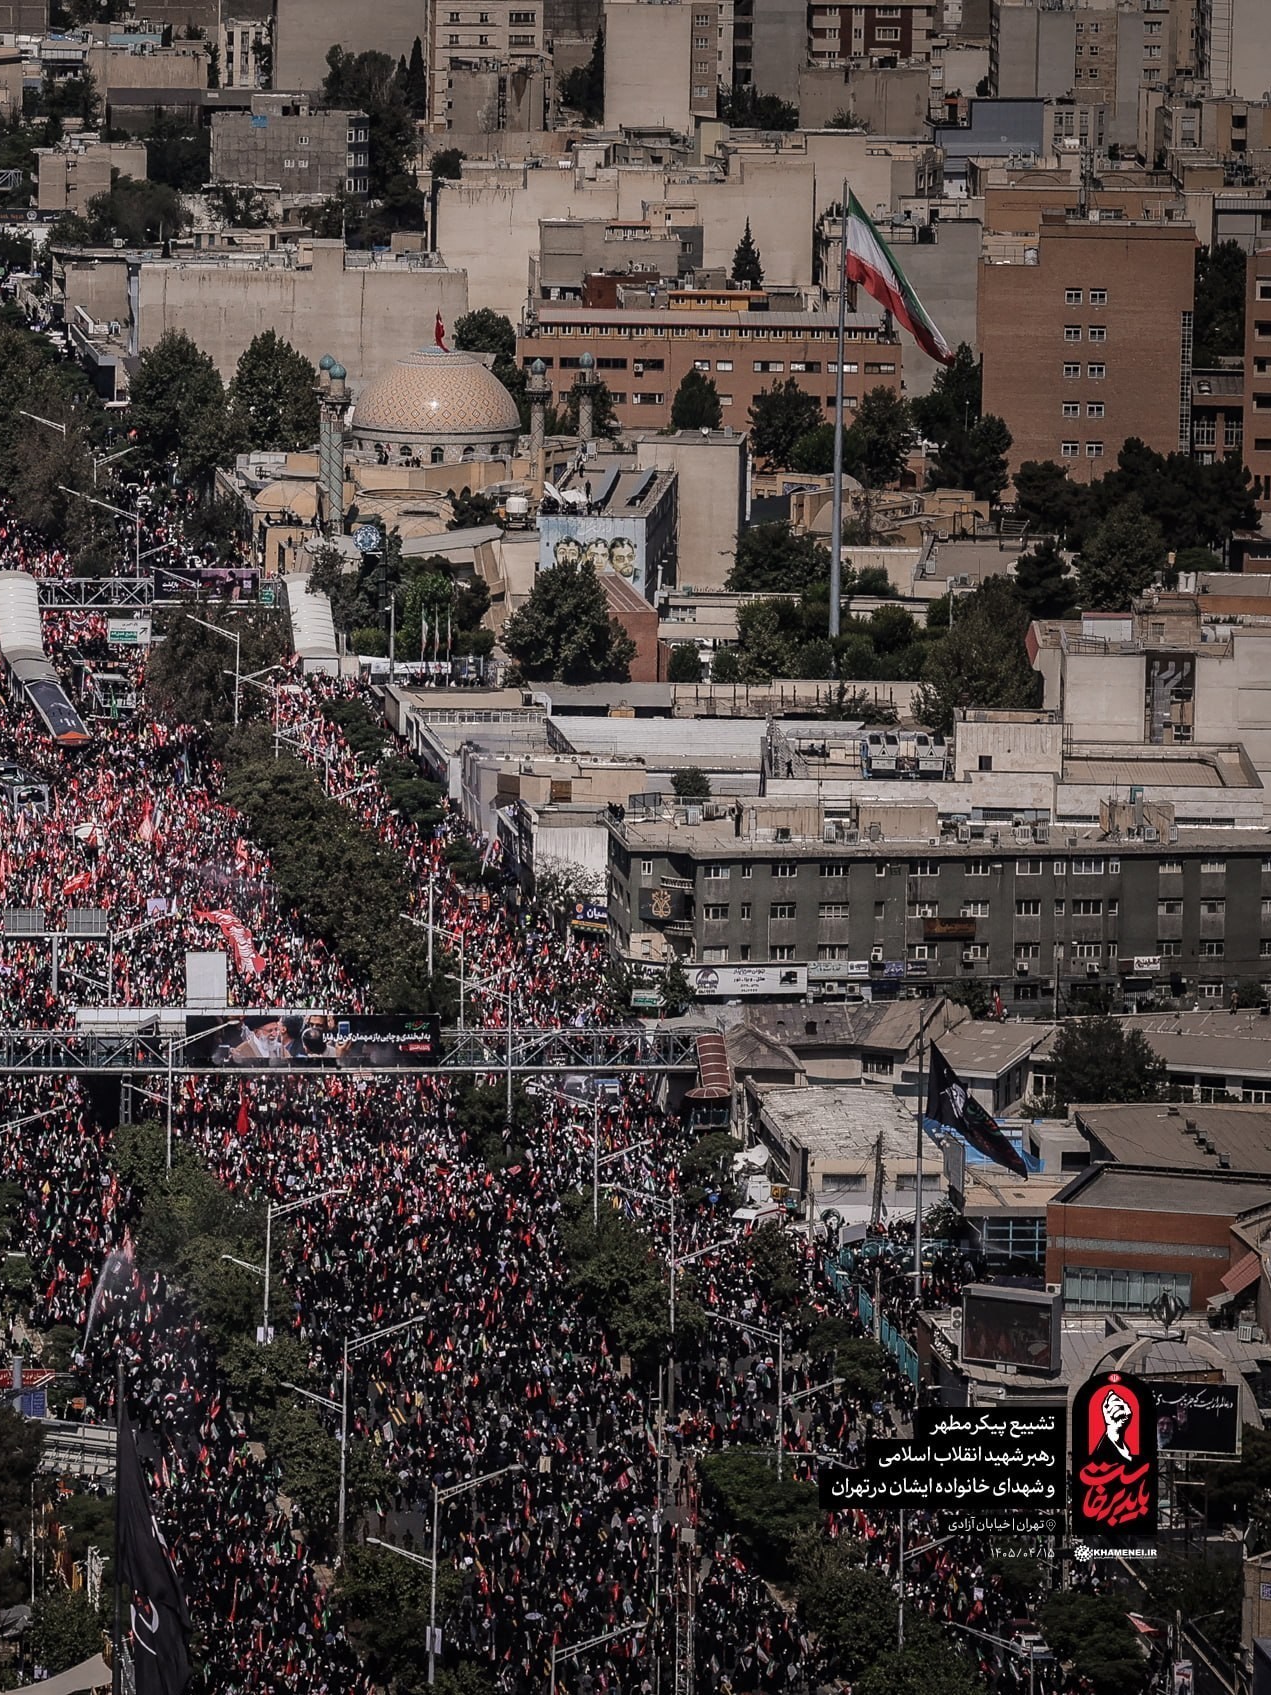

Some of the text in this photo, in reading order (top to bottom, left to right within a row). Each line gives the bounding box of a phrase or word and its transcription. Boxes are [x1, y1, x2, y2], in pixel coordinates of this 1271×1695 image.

[342, 1032, 353, 1043] کن
[352, 1032, 373, 1042] مهمان
[371, 1033, 381, 1042] باز
[380, 1033, 396, 1043] چایی
[400, 1032, 425, 1042] لبخندی
